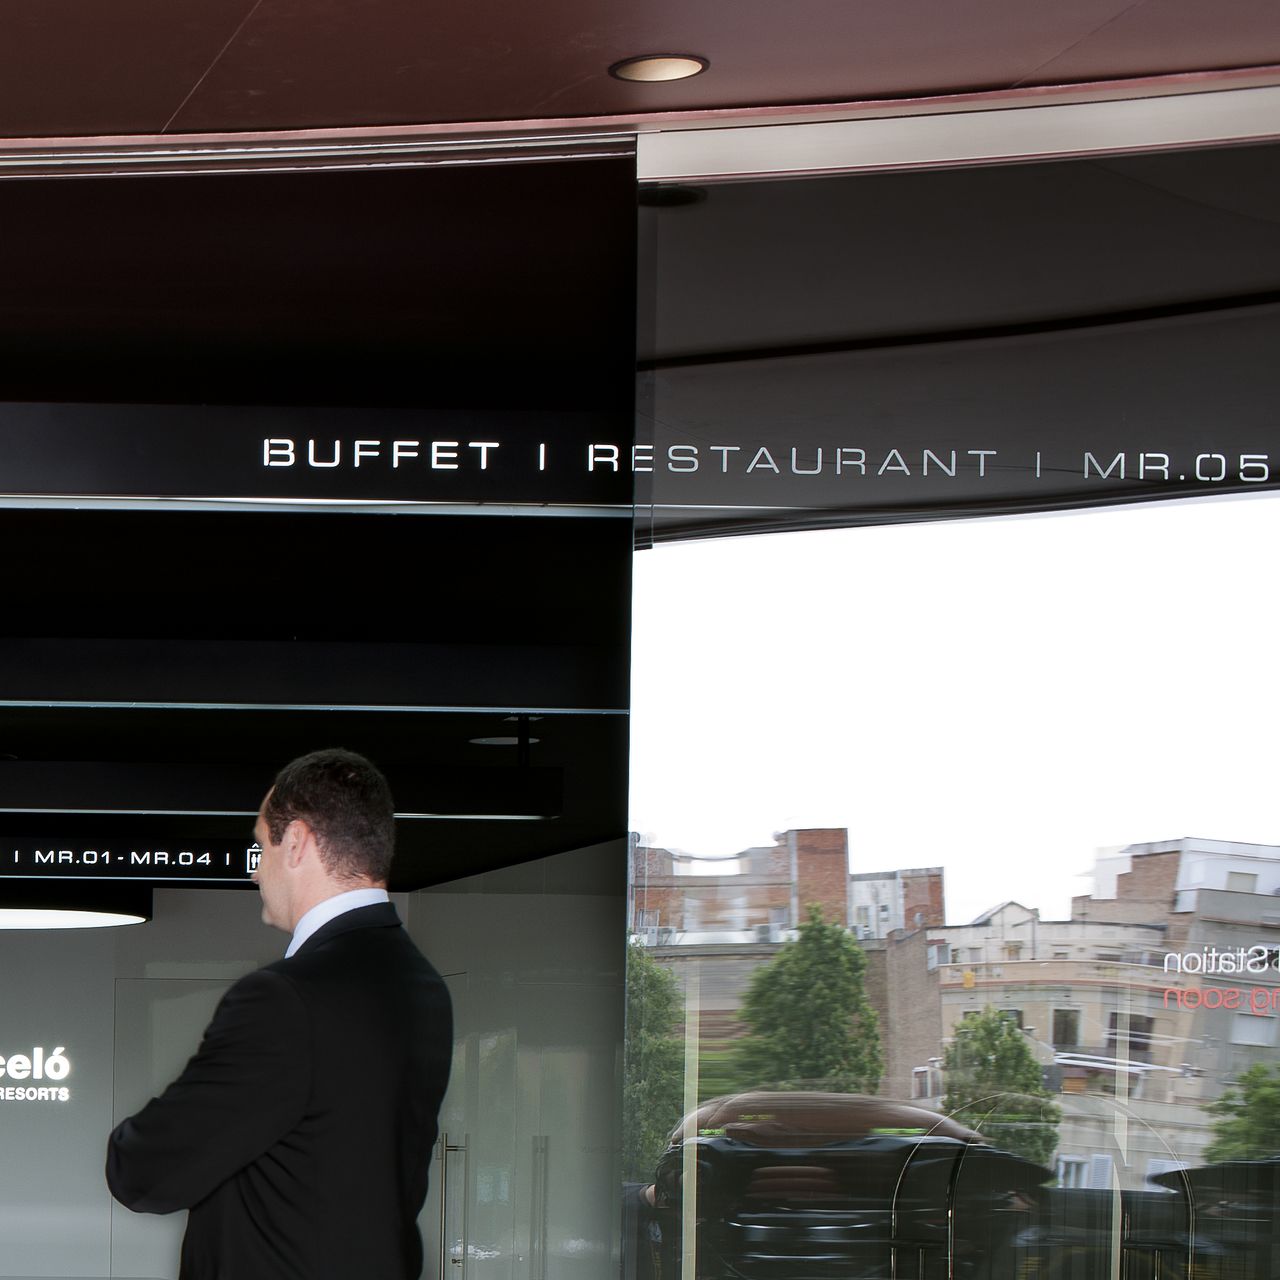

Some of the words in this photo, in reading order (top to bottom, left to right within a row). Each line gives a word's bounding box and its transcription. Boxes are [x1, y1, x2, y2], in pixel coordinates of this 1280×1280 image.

[263, 438, 500, 470] BUFFET
[588, 443, 997, 477] RESTAURANT
[1084, 452, 1269, 482] MR.05
